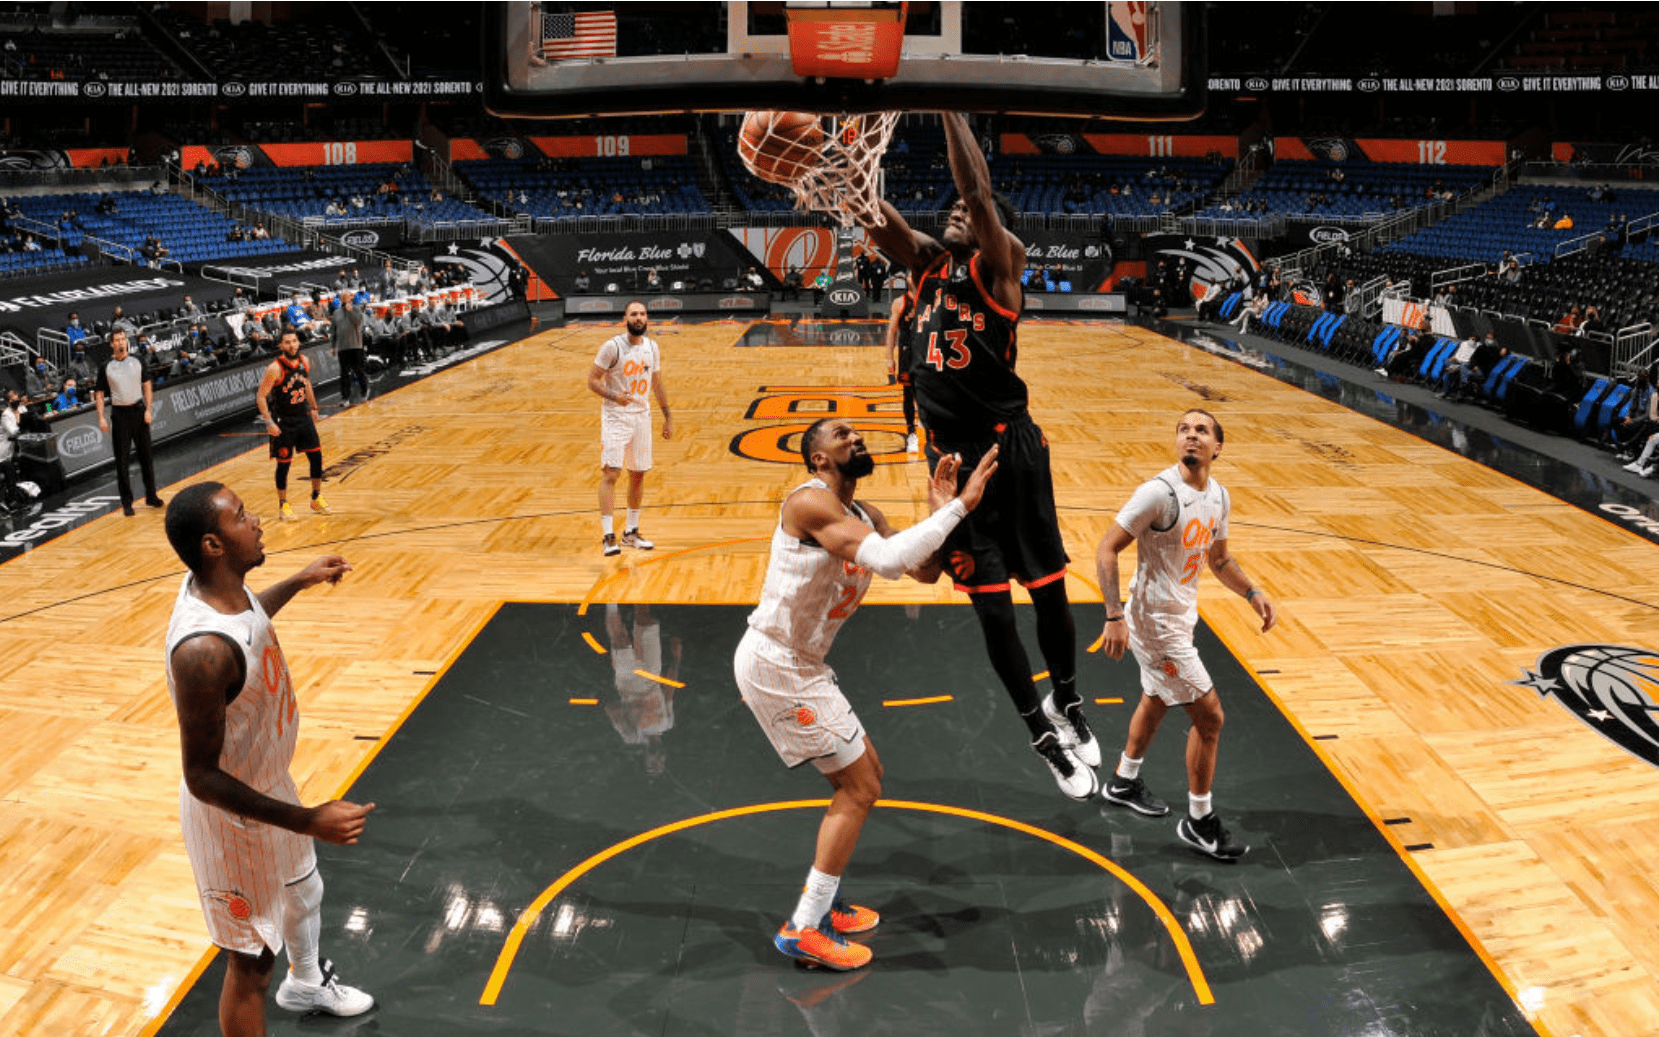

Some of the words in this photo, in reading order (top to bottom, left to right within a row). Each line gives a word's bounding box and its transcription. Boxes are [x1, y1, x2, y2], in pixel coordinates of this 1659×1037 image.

[1112, 41, 1132, 56] NBA
[0, 80, 18, 96] GIVE
[20, 81, 28, 96] IT
[29, 82, 79, 96] EVERYTHING
[108, 83, 123, 96] THE
[124, 83, 160, 96] ALL-NEW
[181, 83, 218, 96] SORENTO
[249, 82, 268, 96] GIVE
[269, 82, 278, 96] IT
[279, 82, 329, 96] EVERYTHING
[359, 82, 376, 95] THE
[377, 82, 411, 95] ALL-NEW
[433, 81, 472, 94] SORENTO
[1207, 78, 1241, 91] ORENTO
[1272, 78, 1290, 91] GIVE
[1291, 78, 1300, 91] IT
[1301, 78, 1352, 91] EVERYTHING
[1383, 78, 1398, 91] THE
[1399, 78, 1434, 91] ALL-NEW
[1455, 78, 1492, 91] SORENTO
[1522, 77, 1541, 91] GIVE
[1543, 77, 1551, 91] IT
[1552, 76, 1602, 91] EVERYTHING
[1631, 75, 1647, 90] THE
[323, 142, 357, 165] 108
[596, 135, 630, 157] 109
[1147, 135, 1173, 157] 111
[1418, 140, 1447, 165] 112
[578, 246, 635, 263] Florida
[638, 244, 673, 260] Blue
[1046, 243, 1080, 259] Blue
[834, 291, 855, 301] KIA
[926, 328, 972, 372] 43
[631, 378, 648, 396] 10
[170, 382, 201, 413] FIELDS
[290, 387, 306, 405] 23
[65, 430, 98, 453] FIELDS
[0, 495, 121, 548] ealth
